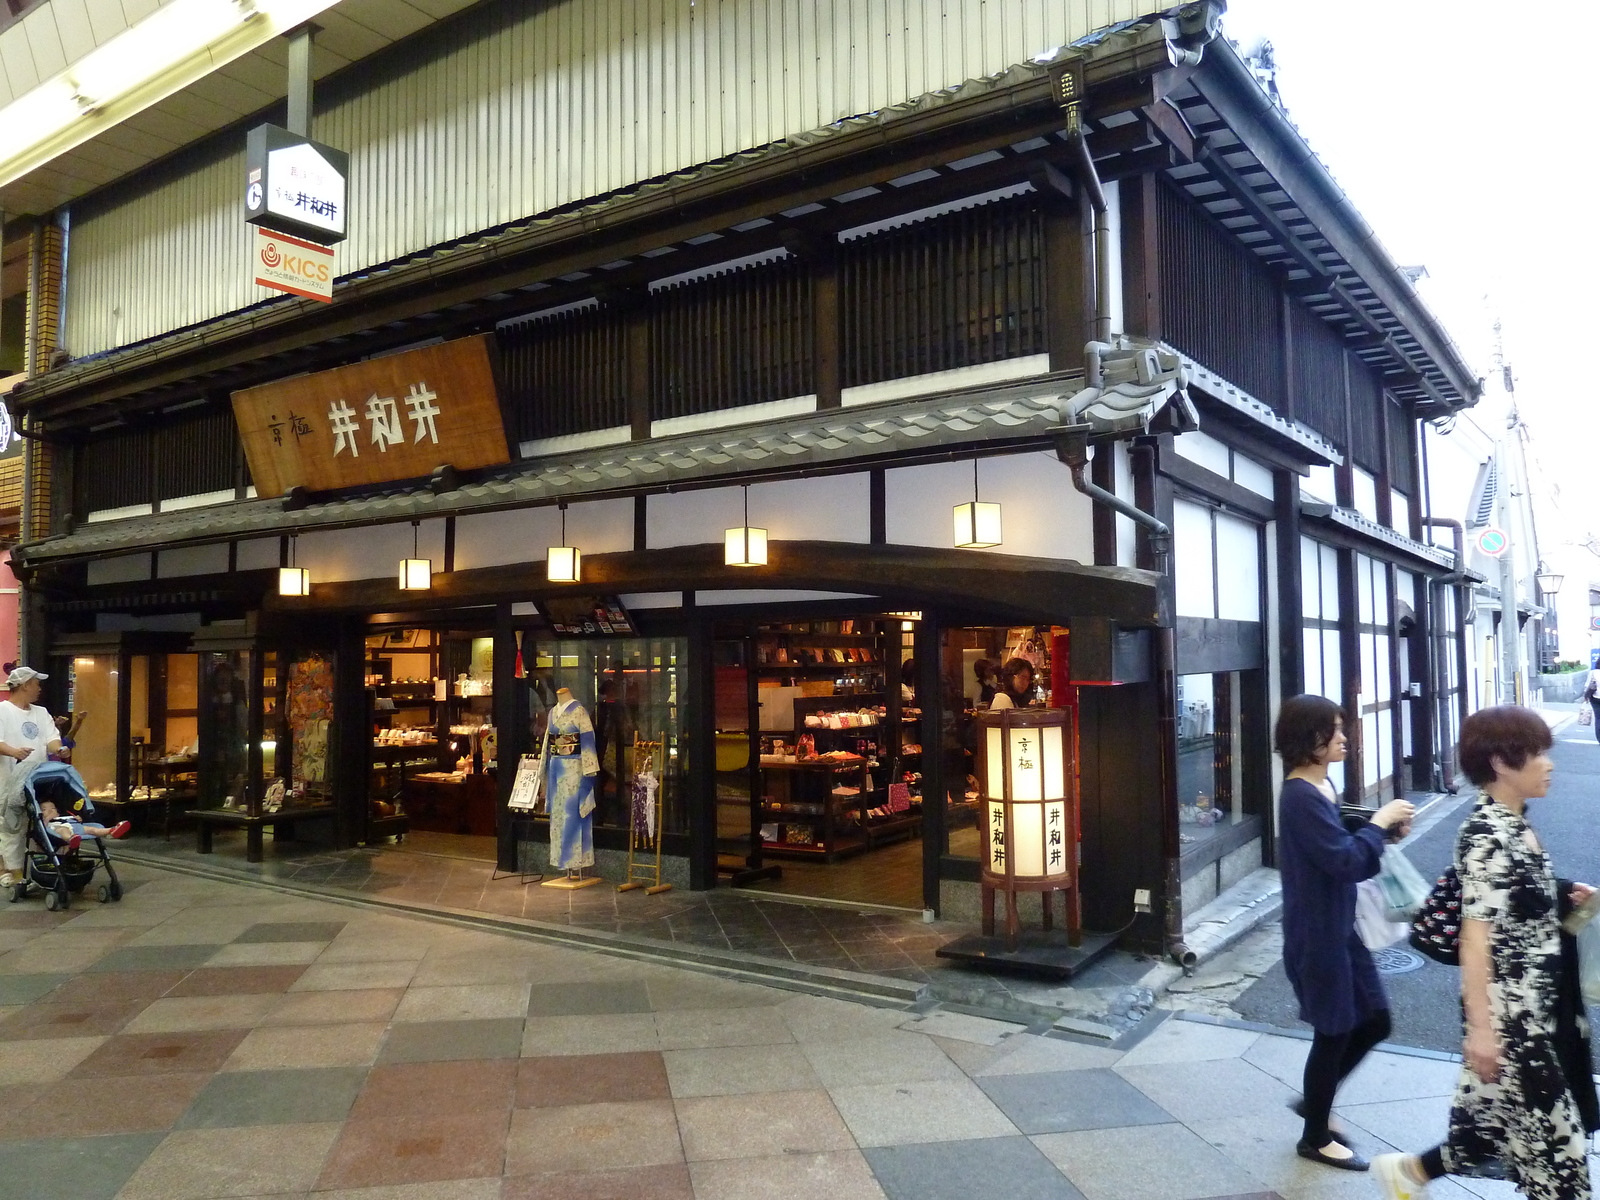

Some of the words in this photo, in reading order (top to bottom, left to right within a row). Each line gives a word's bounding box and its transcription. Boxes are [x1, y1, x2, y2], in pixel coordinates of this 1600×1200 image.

[294, 191, 337, 221] 井和井
[283, 254, 329, 282] KICS
[268, 410, 315, 447] 京極
[327, 381, 441, 458] 井和井
[1018, 738, 1034, 770] 京極
[992, 808, 1005, 866] 井和井
[1049, 808, 1061, 866] 井和井
